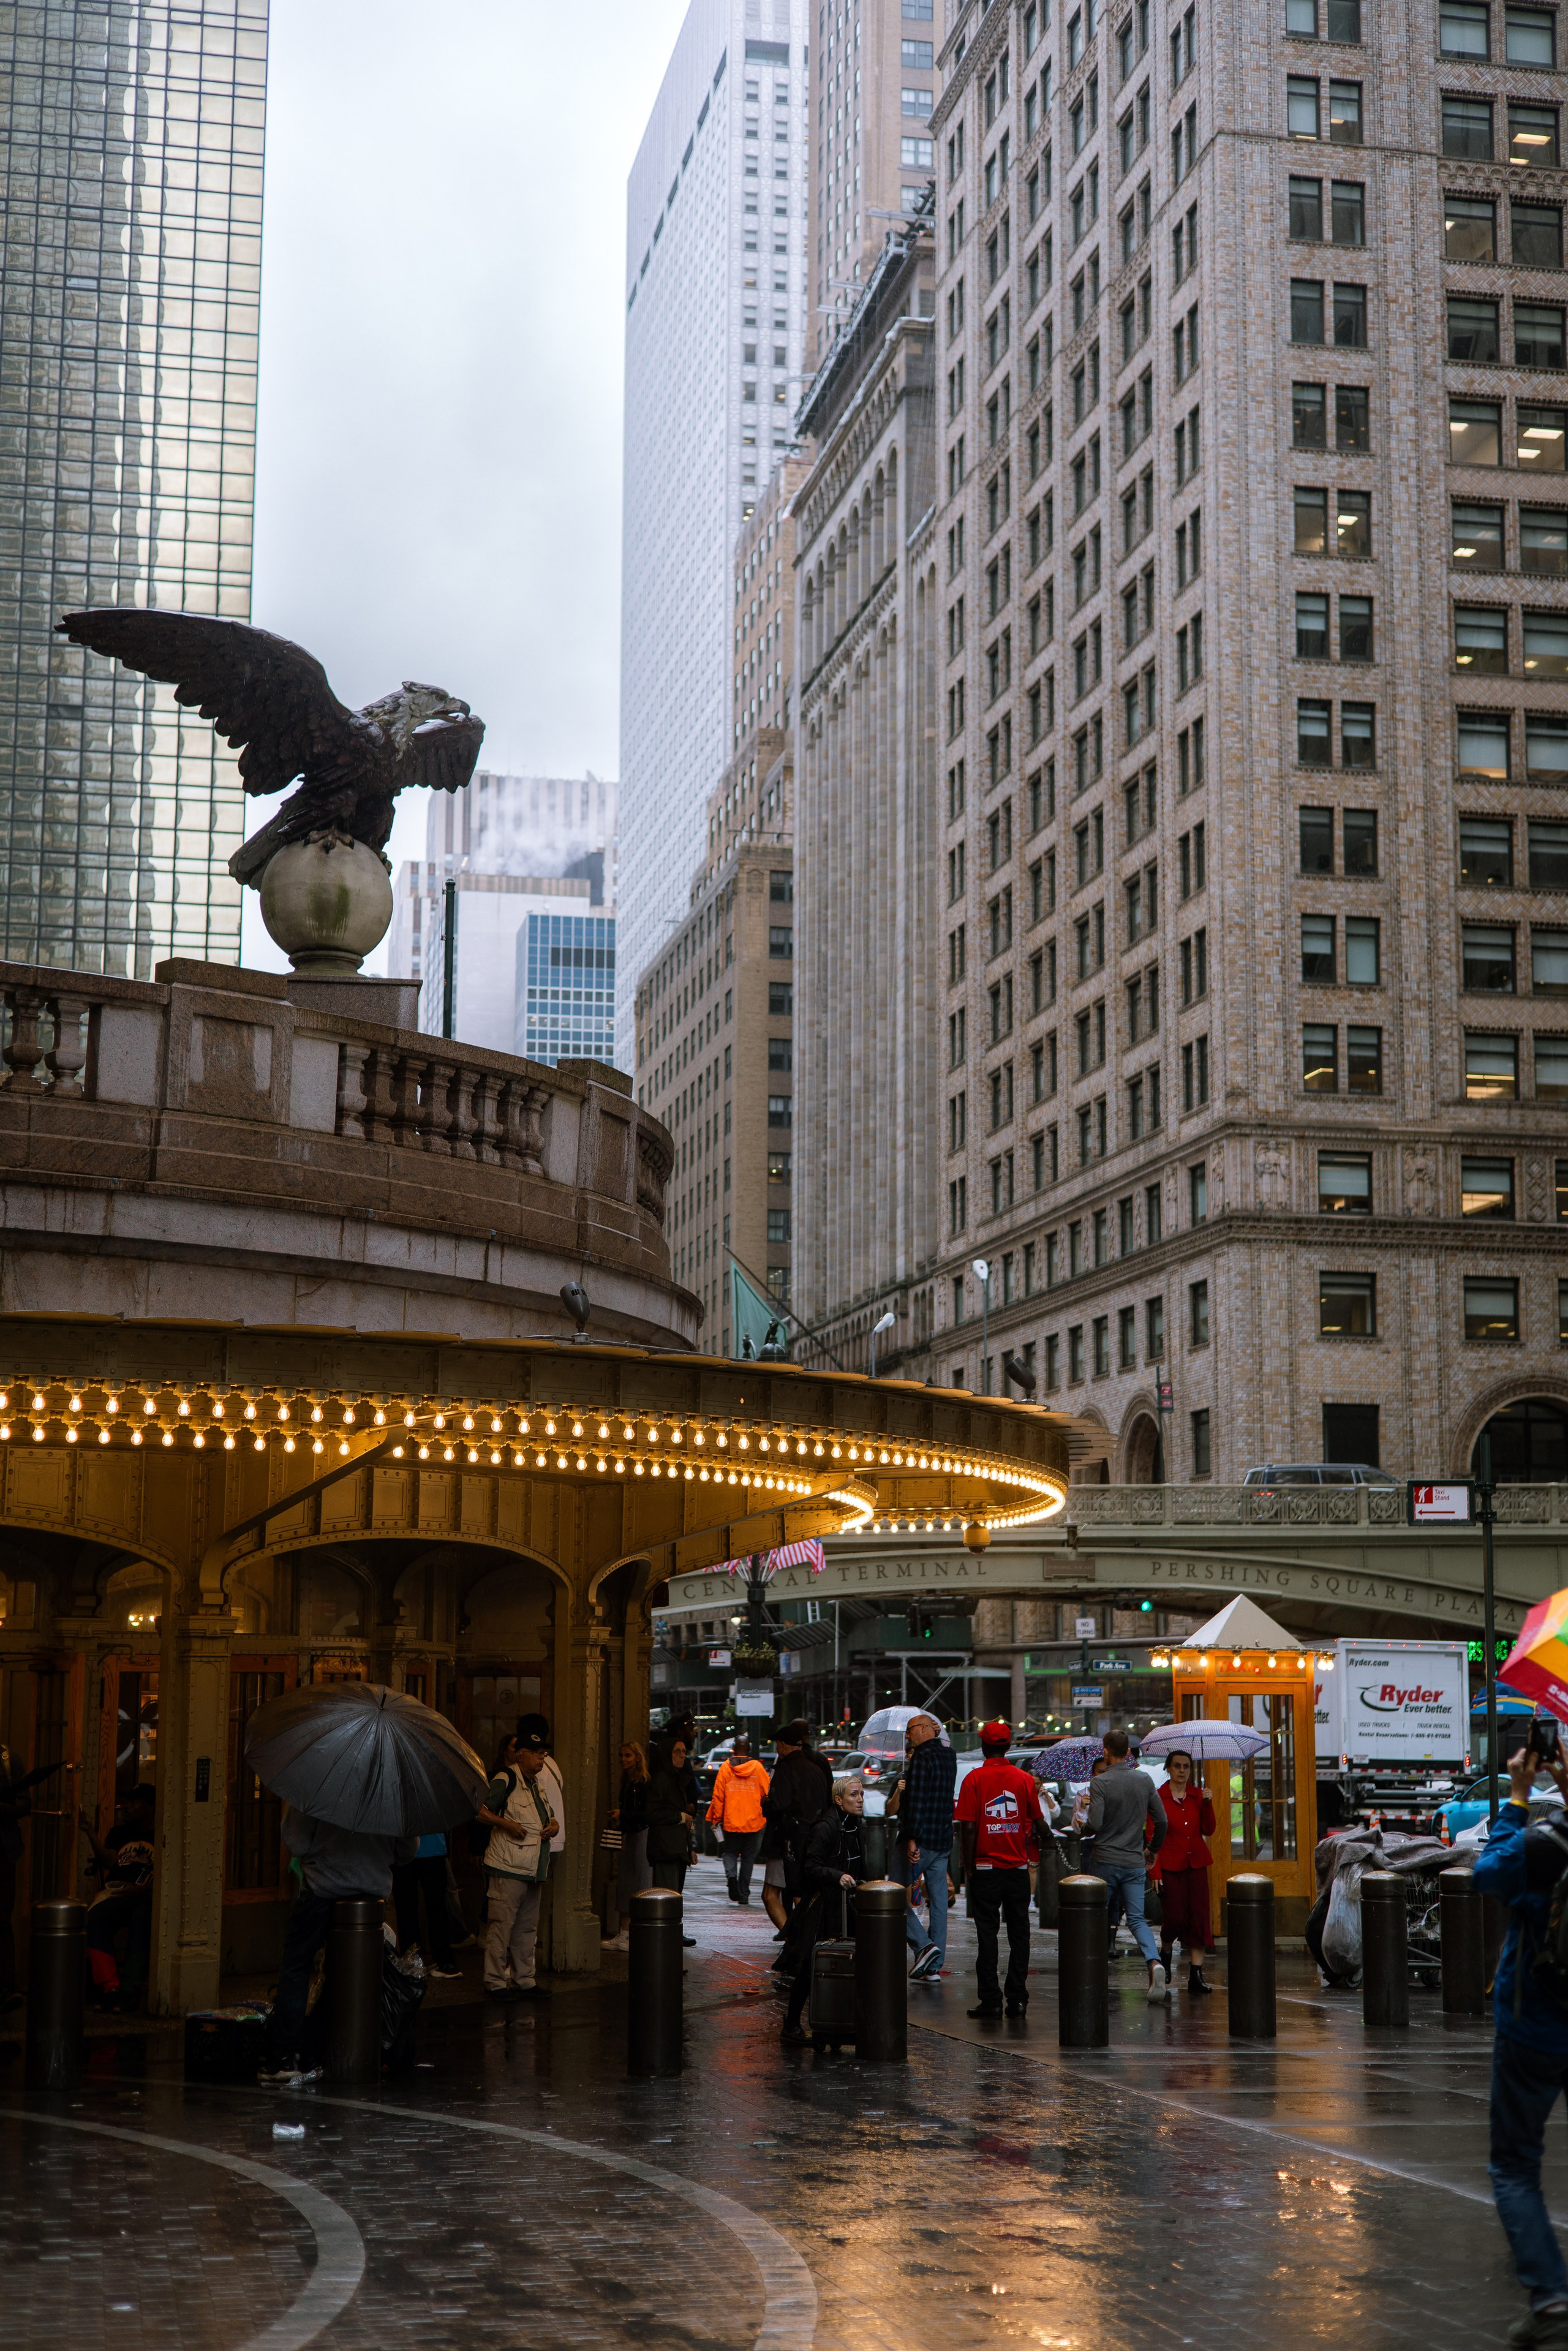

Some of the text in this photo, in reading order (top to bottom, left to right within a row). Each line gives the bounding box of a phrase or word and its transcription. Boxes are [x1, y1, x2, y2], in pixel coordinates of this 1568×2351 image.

[683, 1561, 987, 1599] CENRAL TERMINAL
[1150, 1562, 1517, 1622] PERSHING SQUARE PLAA
[1217, 1661, 1251, 1673] TAXI
[1349, 1658, 1389, 1668] Ryder.com
[1379, 1684, 1444, 1706] Ryder
[1404, 1704, 1452, 1714] Ever better.
[1314, 1709, 1330, 1724] etter.
[986, 1823, 1020, 1832] TOPVIEW
